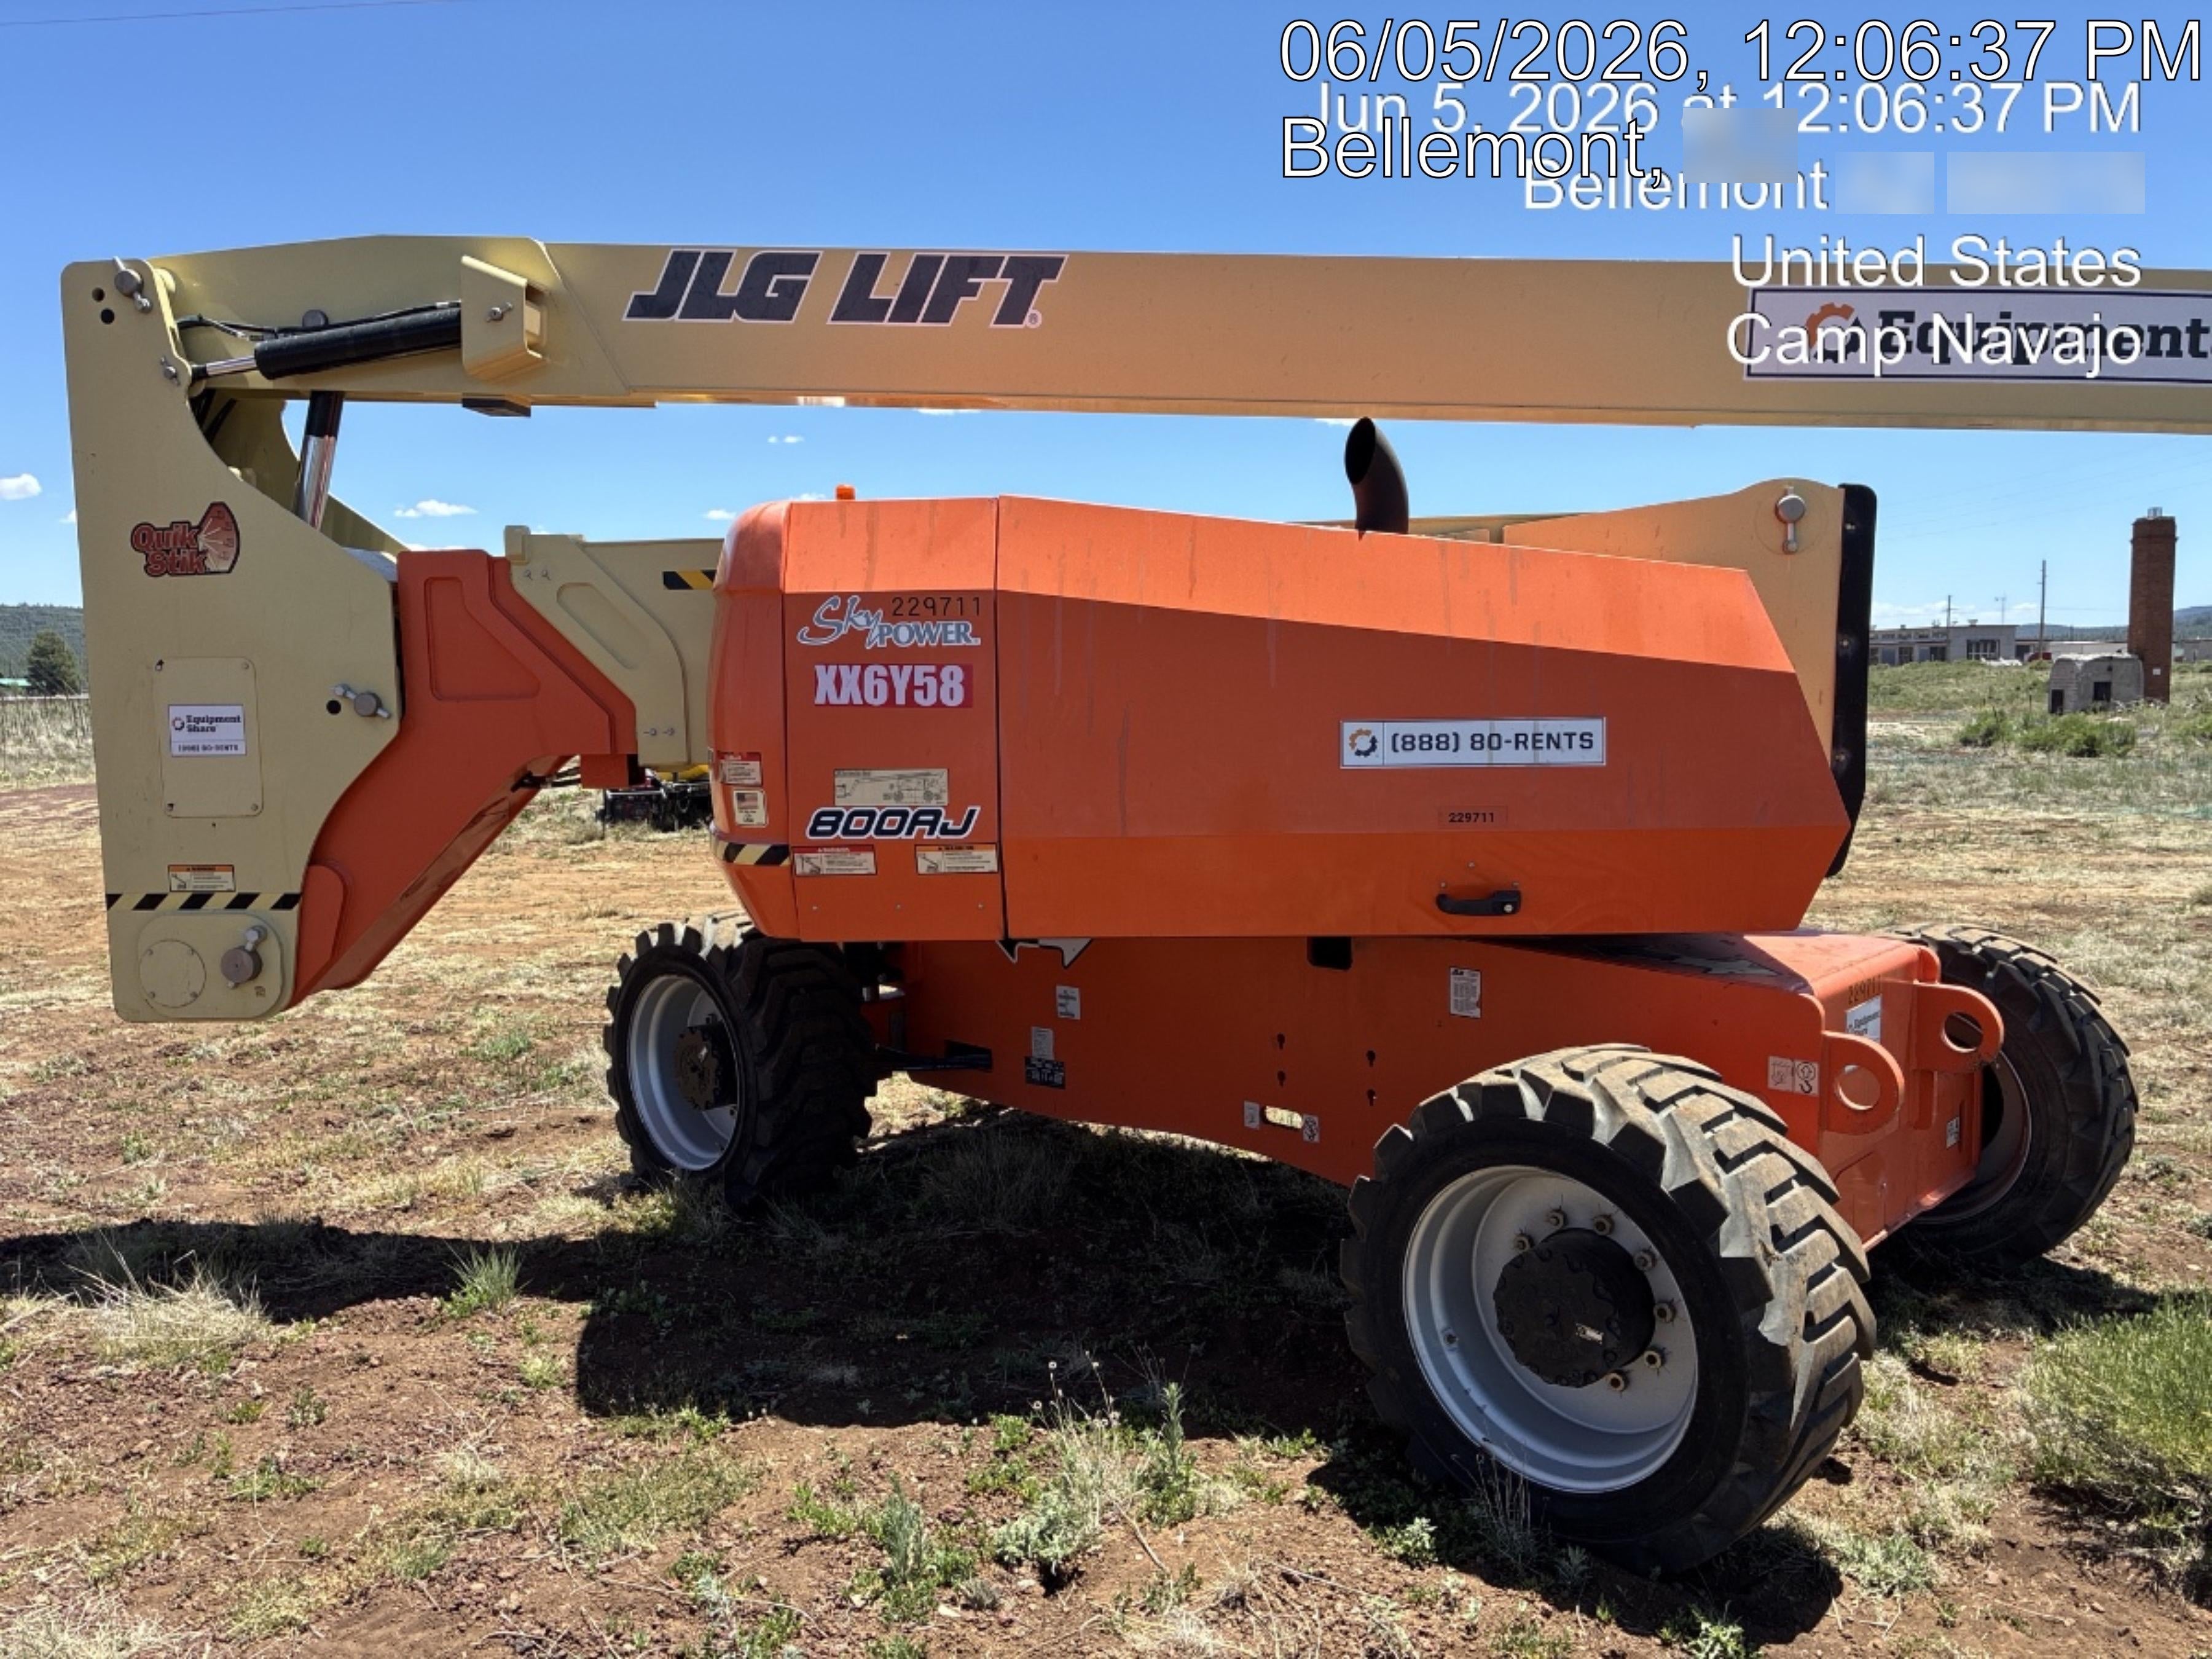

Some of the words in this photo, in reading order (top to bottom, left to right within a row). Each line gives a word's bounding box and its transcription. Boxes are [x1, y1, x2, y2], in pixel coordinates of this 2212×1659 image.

[622, 249, 823, 323] JLG
[826, 252, 1069, 327] LIFT
[132, 524, 200, 551] Quik
[146, 550, 206, 575] Stik
[891, 596, 981, 616] 229711
[797, 594, 883, 649] Sky
[876, 621, 970, 648] POWER
[814, 664, 965, 707] XX6Y58
[1390, 732, 1460, 753] (888)
[1470, 731, 1594, 751] 80-RENTS
[806, 805, 982, 840] 800AJ
[1448, 812, 1495, 823] 229711
